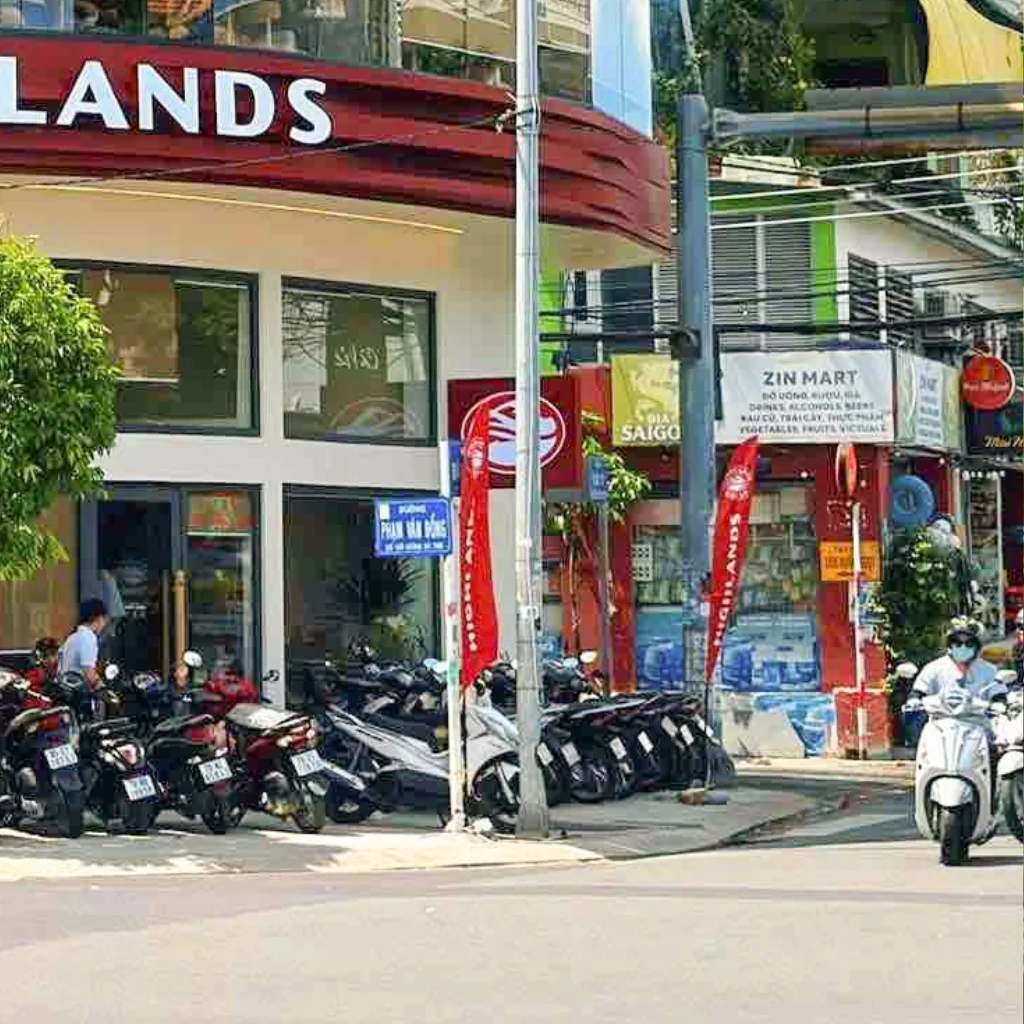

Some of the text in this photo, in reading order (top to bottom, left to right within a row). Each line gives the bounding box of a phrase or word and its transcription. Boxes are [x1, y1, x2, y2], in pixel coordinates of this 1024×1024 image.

[763, 370, 858, 386] ZIN MART
[621, 424, 681, 441] SAIGO
